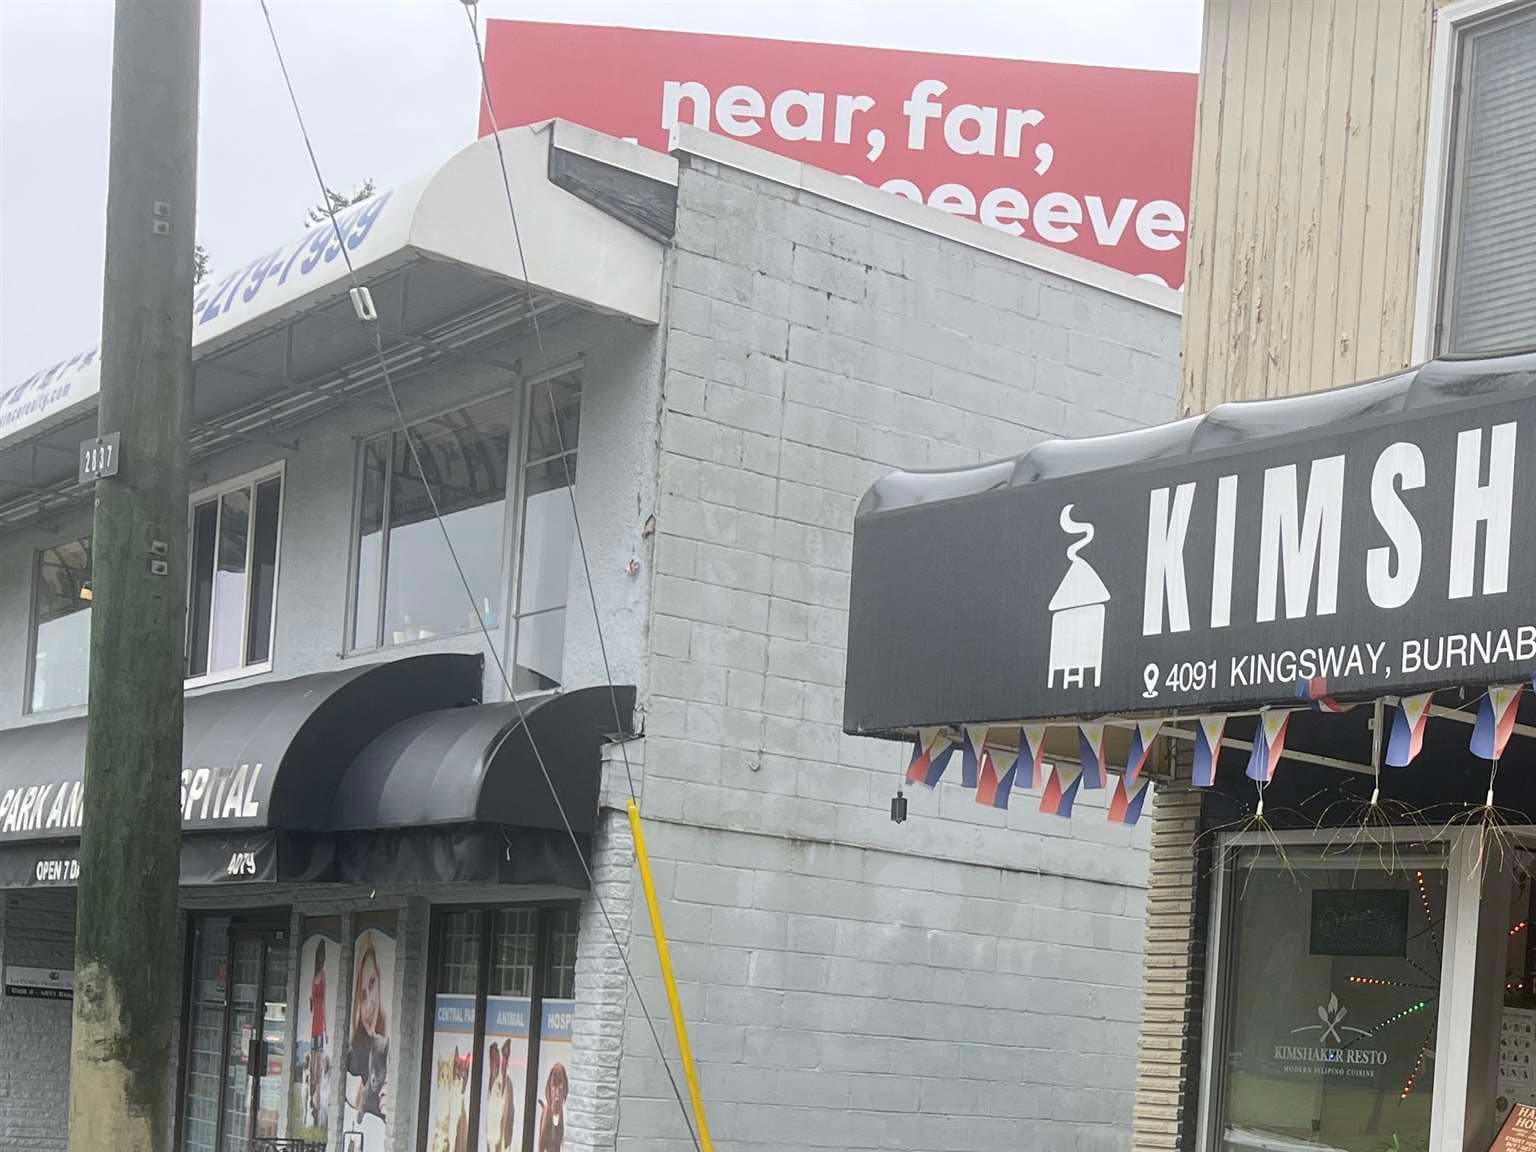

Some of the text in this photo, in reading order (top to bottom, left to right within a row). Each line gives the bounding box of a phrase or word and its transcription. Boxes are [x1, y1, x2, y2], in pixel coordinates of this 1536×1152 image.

[661, 80, 1054, 175] near, far,
[1164, 661, 1218, 694] 4091
[1229, 640, 1391, 688] KINGSWAY,
[0, 784, 54, 832] PARK
[36, 860, 62, 881] OPEN
[63, 860, 71, 881] 7
[496, 1010, 525, 1028] ANIMAL
[1274, 1045, 1388, 1065] KIMSHAKER RESTO
[1284, 1065, 1375, 1078] MODERN FILIPINO CUISINE
